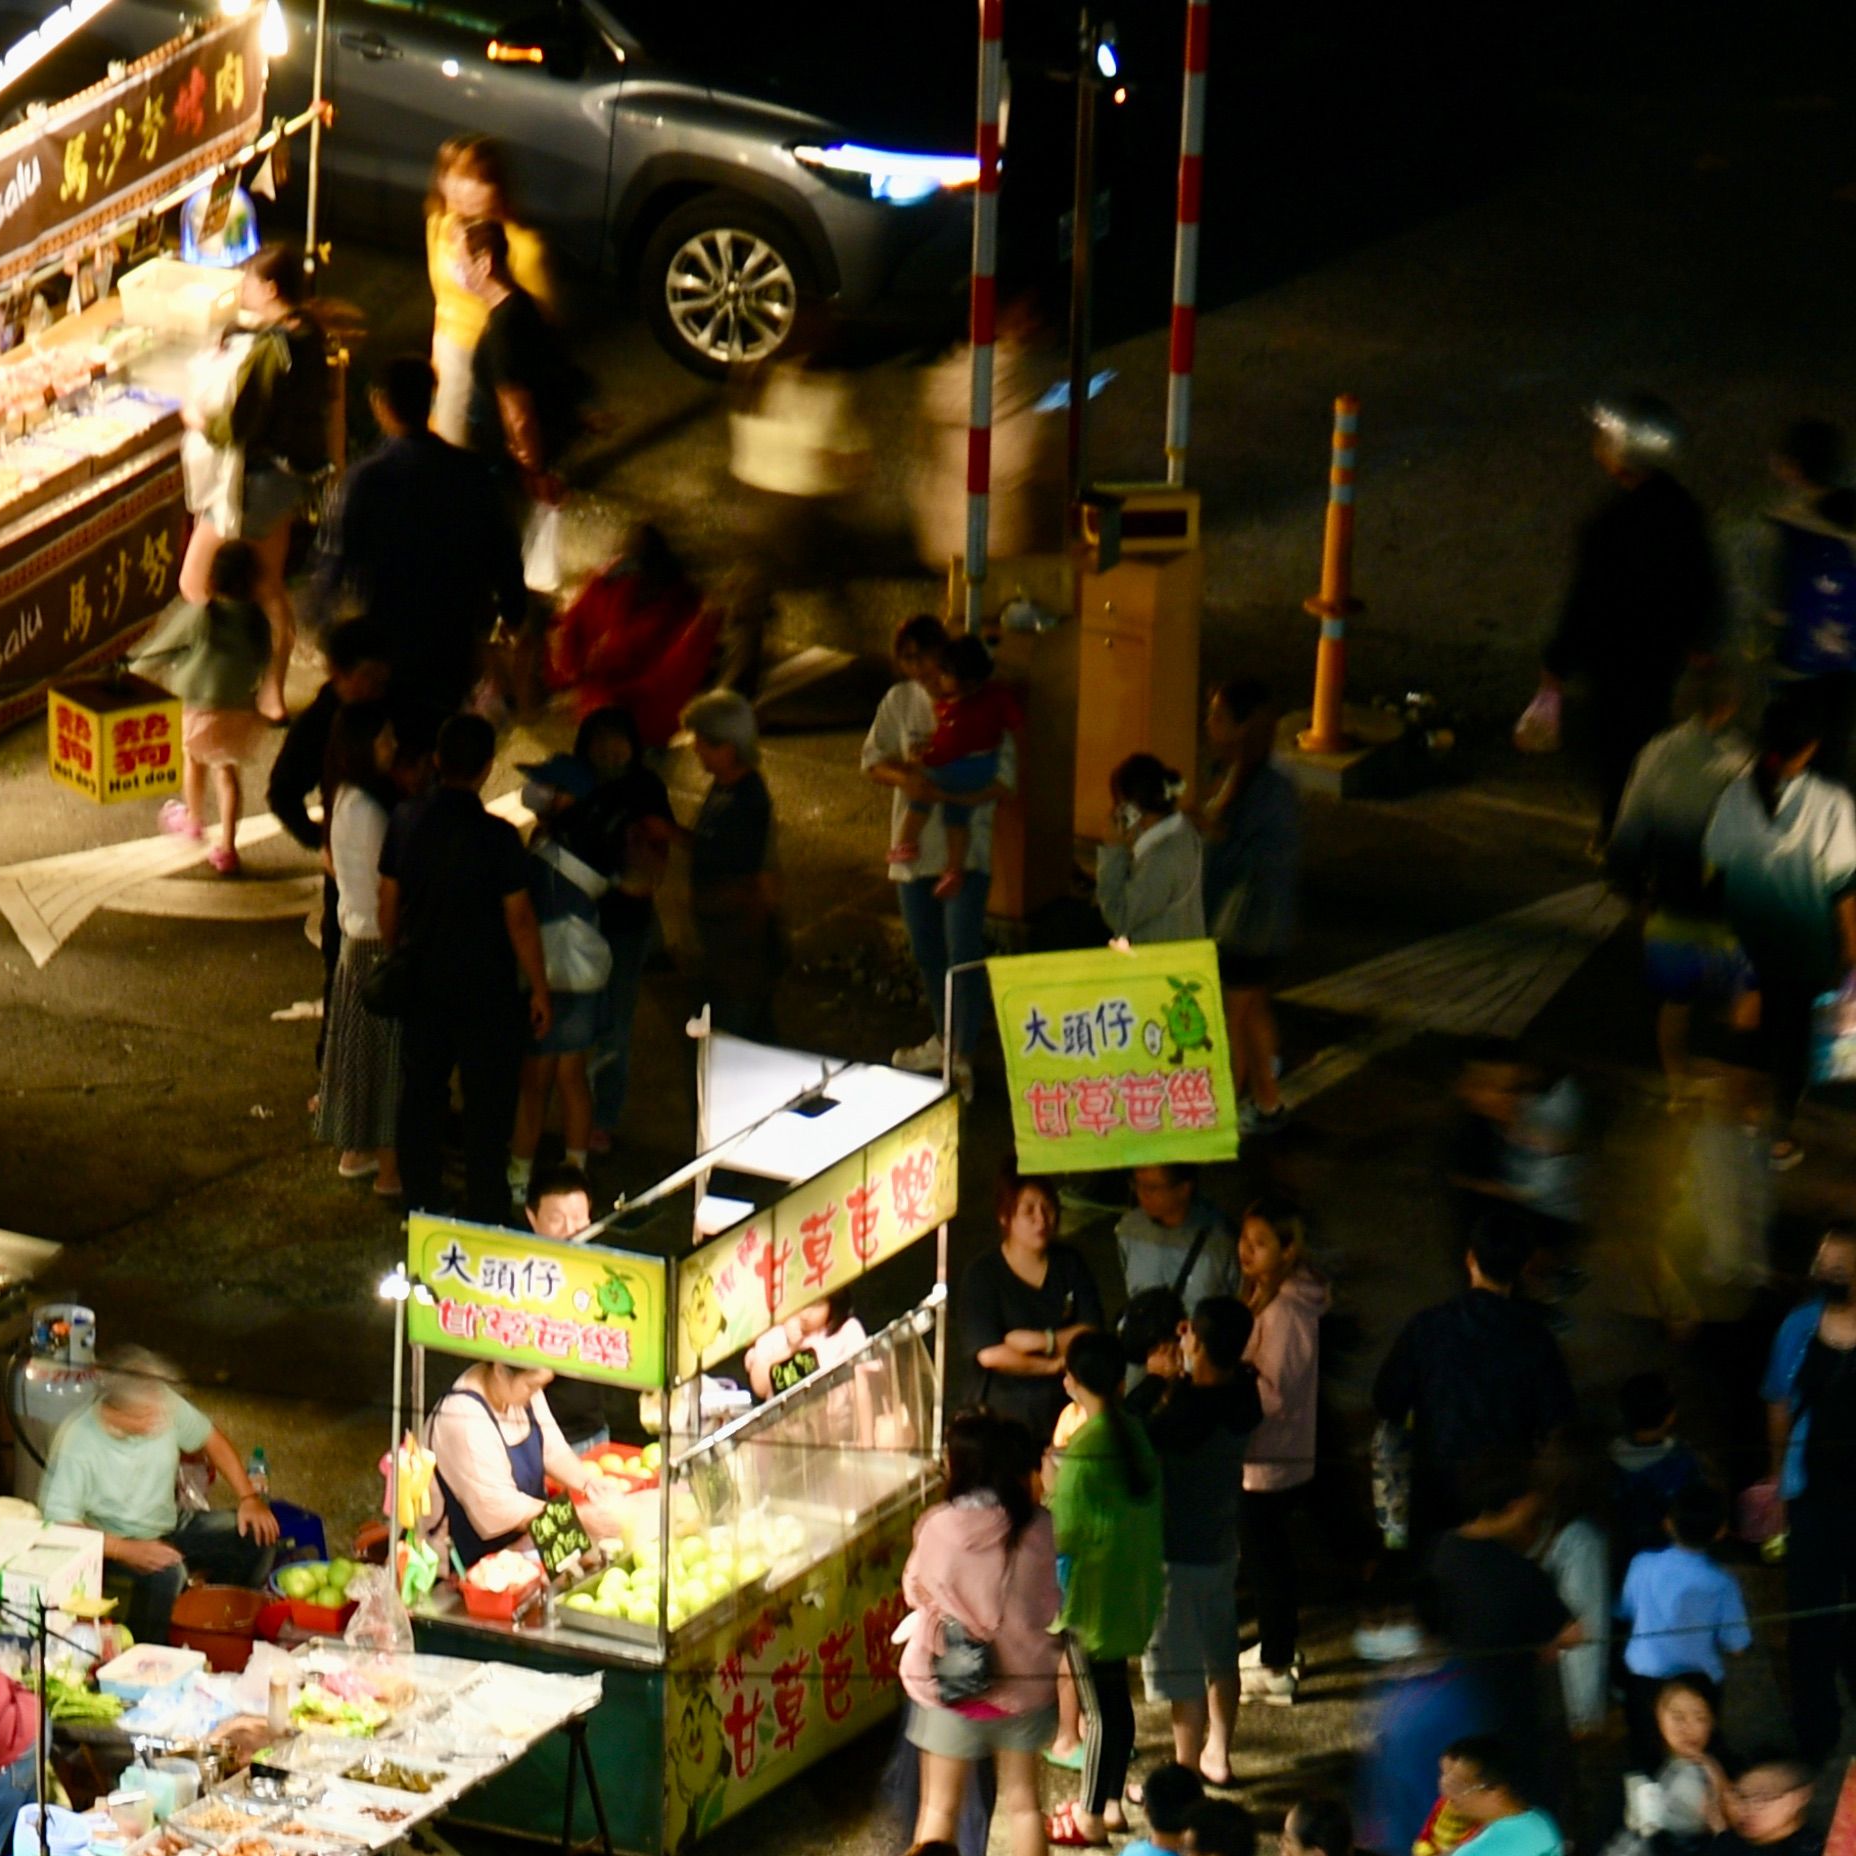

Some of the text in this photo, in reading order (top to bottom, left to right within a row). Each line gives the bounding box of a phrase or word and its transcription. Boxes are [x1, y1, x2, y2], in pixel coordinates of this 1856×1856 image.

[109, 769, 177, 793] Hot dog
[1024, 1000, 1135, 1057] 大頭仔
[1026, 1067, 1217, 1137] 甘草芭樂
[754, 1147, 936, 1314] 甘草芭樂
[435, 1241, 561, 1299] 大頭仔
[437, 1299, 632, 1370] 甘草芭樂
[723, 1590, 905, 1779] 甘草芭樂
